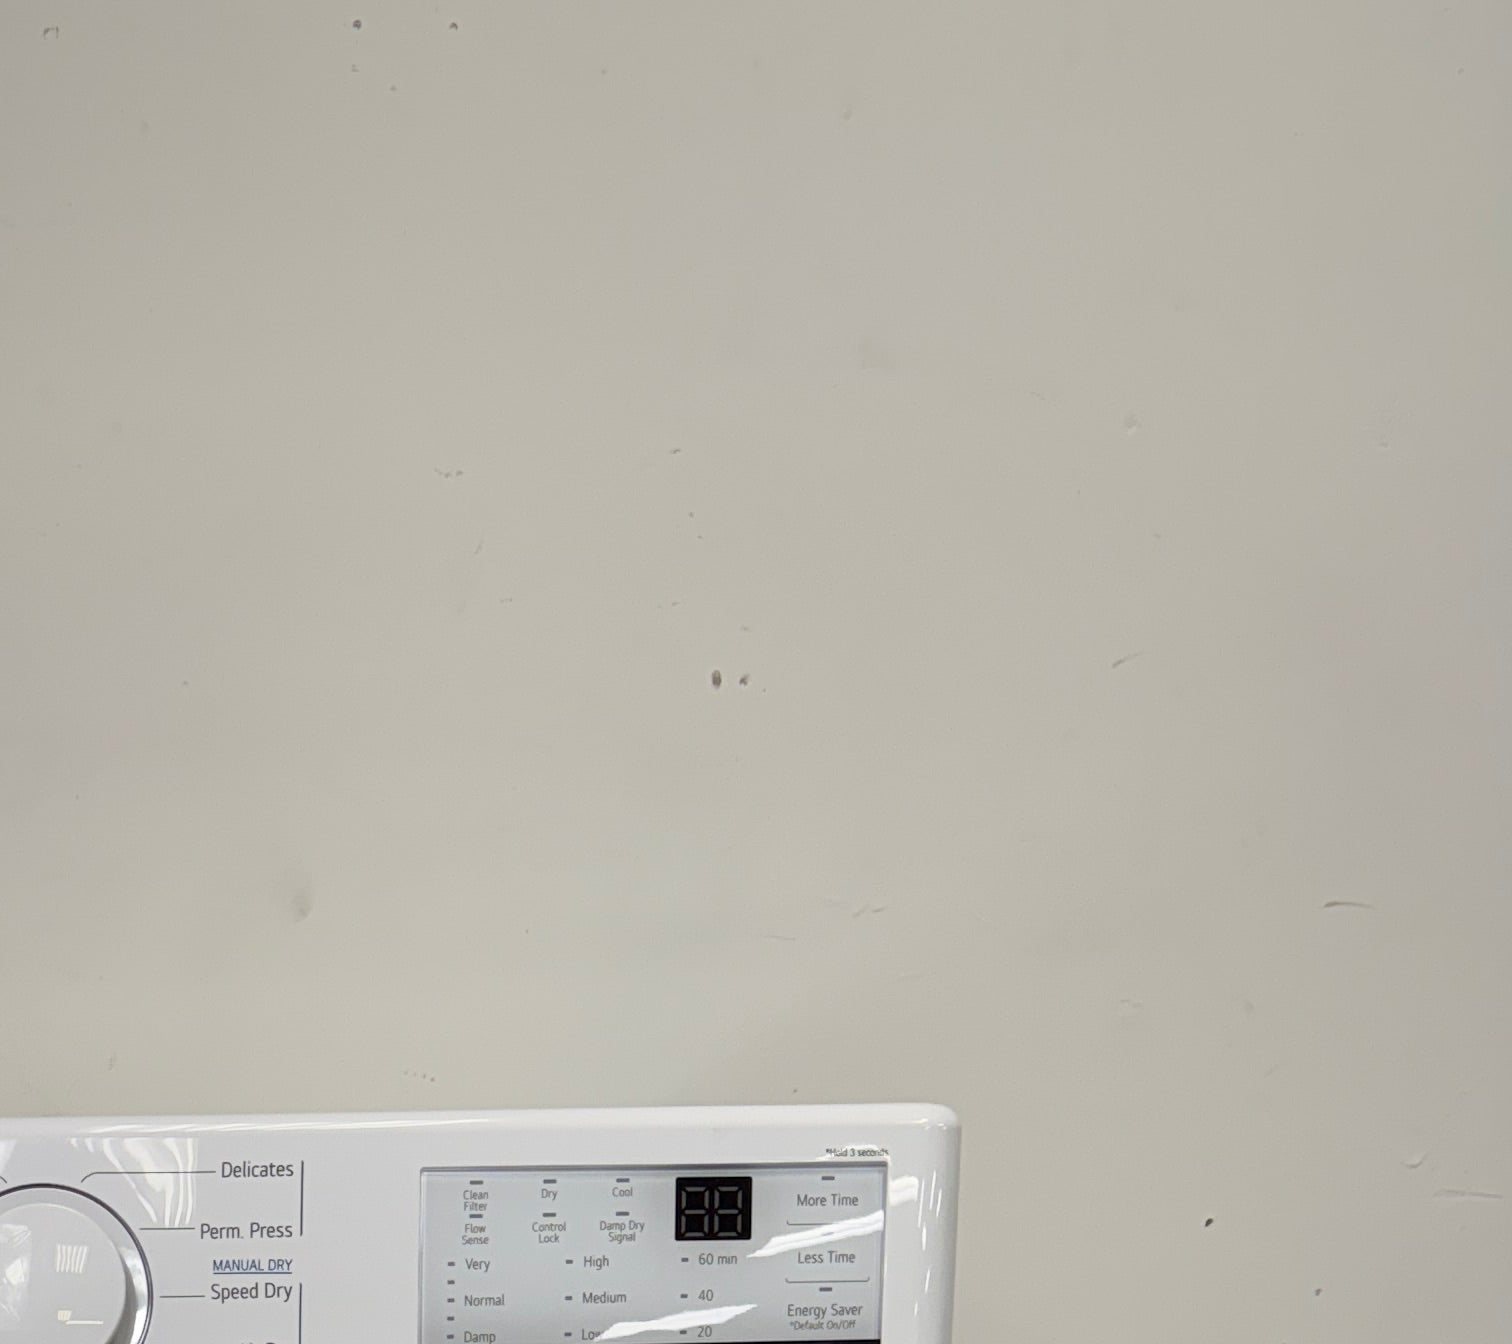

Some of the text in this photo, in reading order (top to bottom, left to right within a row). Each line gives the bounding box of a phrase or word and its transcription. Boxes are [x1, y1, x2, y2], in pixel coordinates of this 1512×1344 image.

[221, 1160, 294, 1178] Delicates
[463, 1189, 489, 1200] Clean
[541, 1189, 558, 1201] Dry
[612, 1187, 633, 1197] Cool
[796, 1193, 859, 1206] More Time
[463, 1201, 488, 1211] Filter
[201, 1222, 293, 1239] Perm. Press
[464, 1223, 486, 1234] Flow
[532, 1222, 567, 1232] Control
[600, 1220, 645, 1233] Damp Dry
[462, 1235, 489, 1245] Sense
[538, 1232, 560, 1243] Lock
[608, 1232, 636, 1244] Signal
[583, 1256, 610, 1270] High
[698, 1253, 738, 1265] 60 min
[797, 1251, 856, 1264] Less Time
[213, 1259, 293, 1272] MANUAL DRY
[465, 1258, 490, 1272] Very
[211, 1282, 293, 1304] Speed Dry
[582, 1292, 627, 1304] Medium
[698, 1289, 714, 1301] 40
[464, 1294, 505, 1307] Normal
[787, 1304, 863, 1319] Energy Saver
[827, 1320, 856, 1330] On/Off
[464, 1331, 496, 1344] Damp
[697, 1326, 713, 1337] 20
